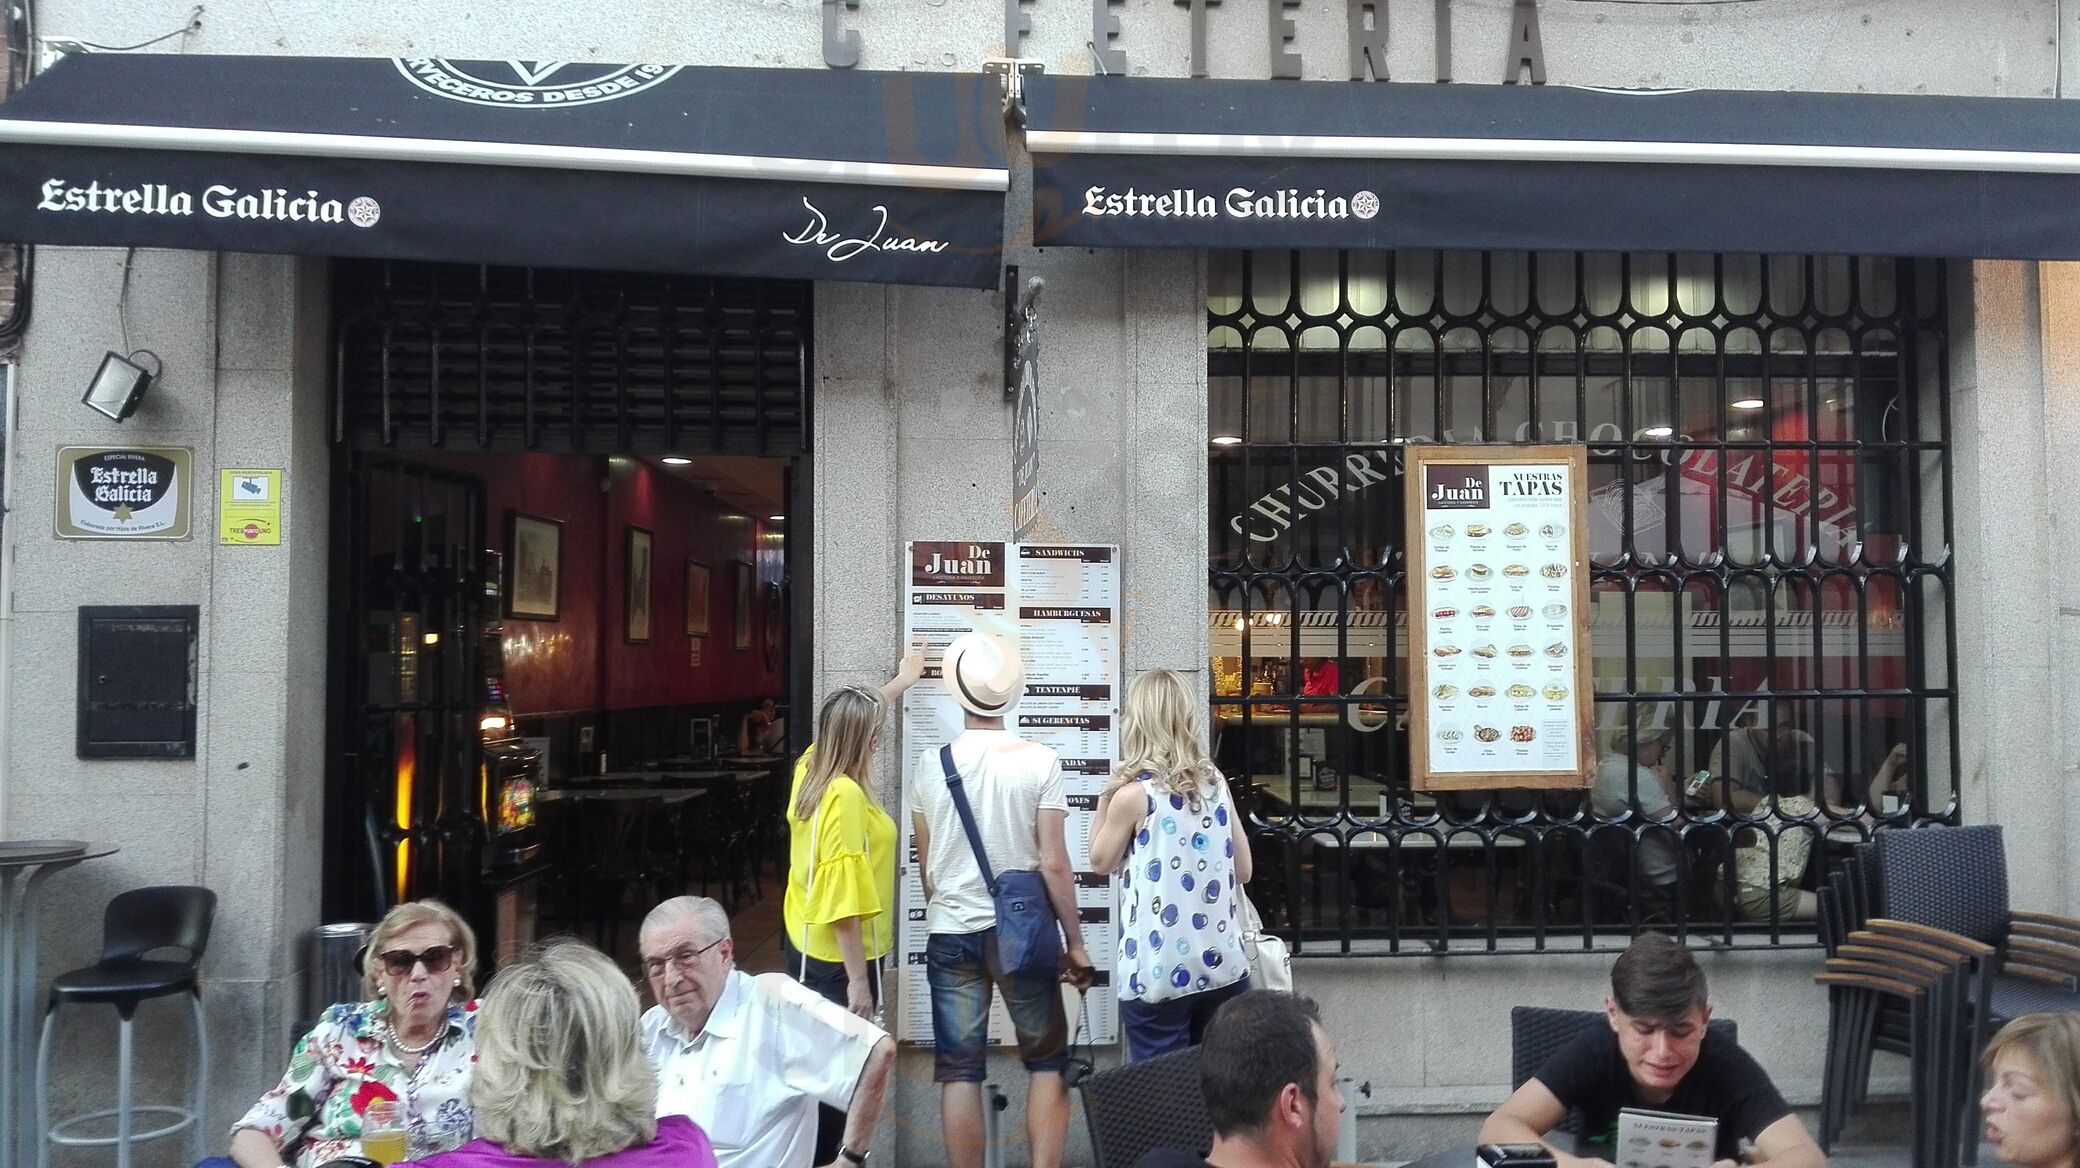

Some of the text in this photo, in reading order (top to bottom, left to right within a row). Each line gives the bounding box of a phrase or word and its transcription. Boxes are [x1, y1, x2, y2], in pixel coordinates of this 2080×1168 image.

[543, 76, 638, 102] DESDE
[37, 178, 344, 223] Estrella Galicia
[1082, 185, 1349, 220] Estrella Galicia
[783, 196, 949, 262] De Juan
[90, 466, 158, 485] Estrella
[1465, 477, 1483, 488] De
[1513, 473, 1563, 481] NUESTRAS
[94, 484, 152, 502] Galicia
[1432, 484, 1484, 500] Juan
[1499, 481, 1563, 496] TAPAS
[968, 545, 991, 559] De
[925, 553, 992, 574] Juan
[926, 593, 975, 601] DESAYUNOS
[1033, 609, 1102, 617] HAMBURGUESAS
